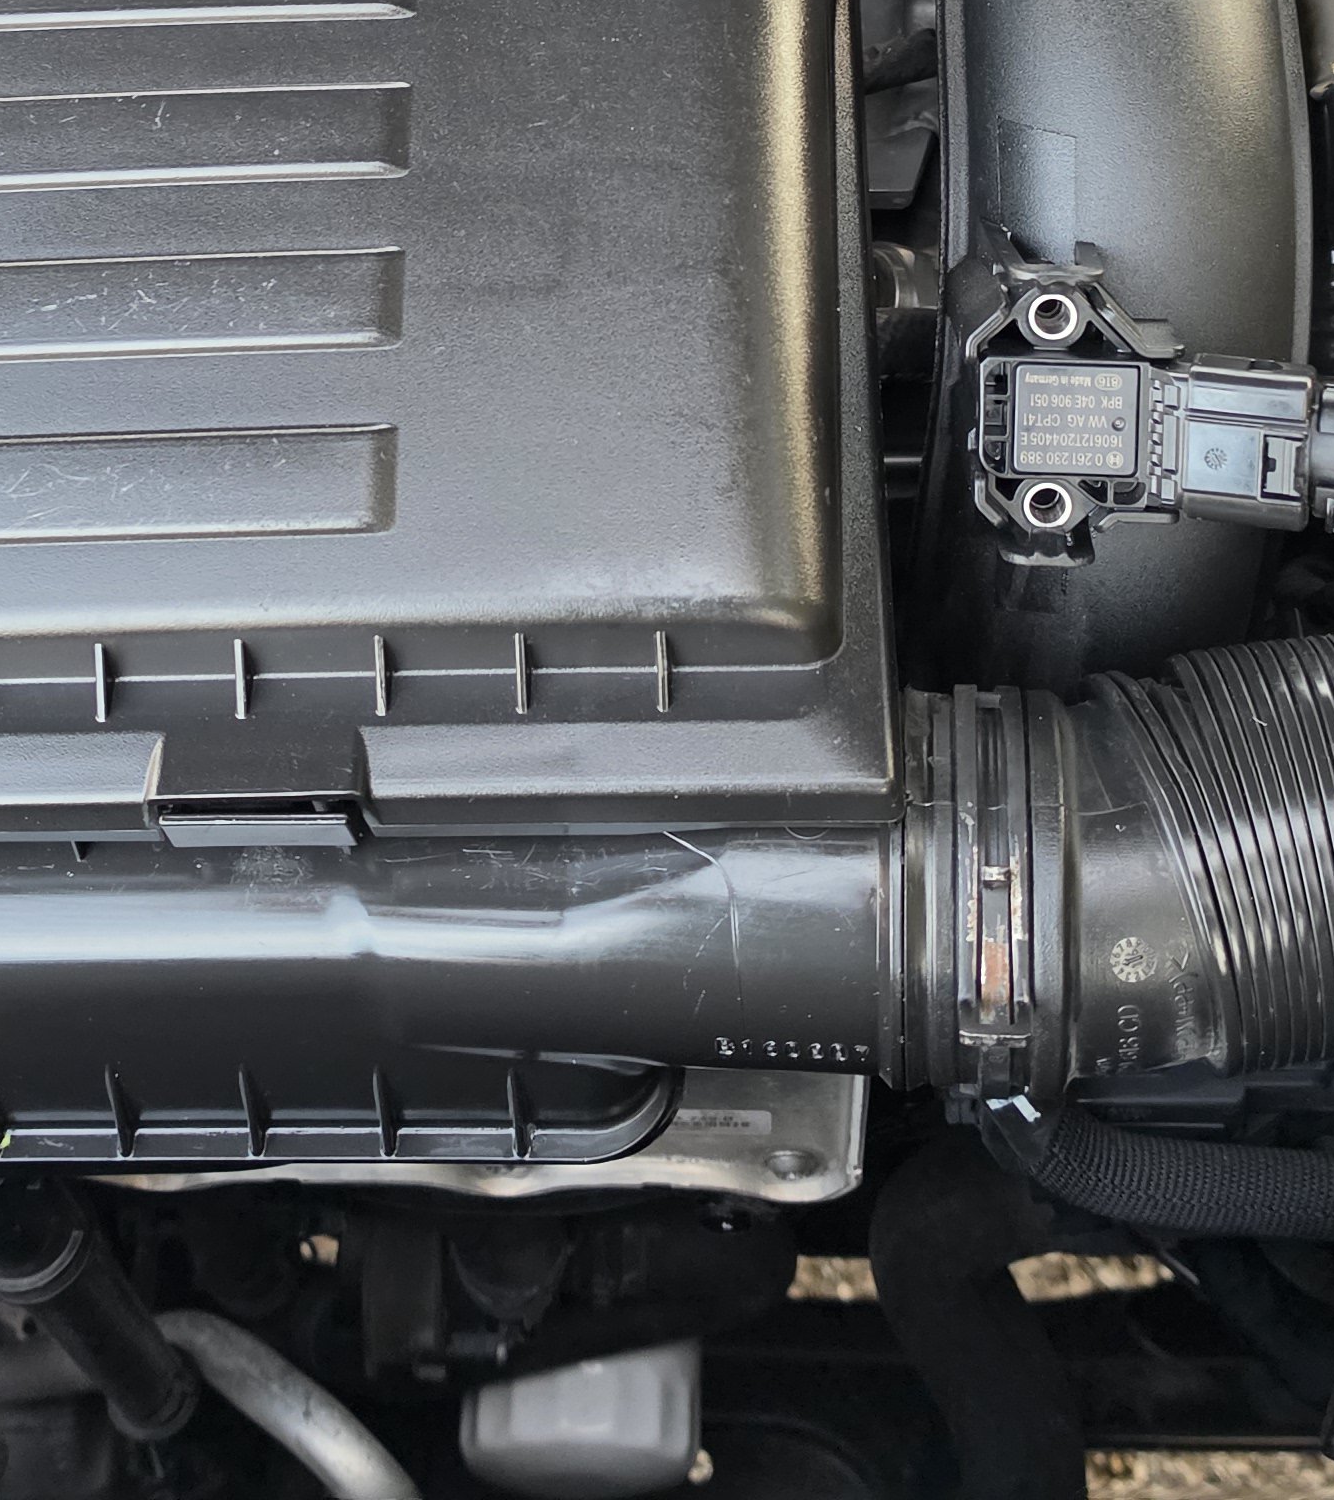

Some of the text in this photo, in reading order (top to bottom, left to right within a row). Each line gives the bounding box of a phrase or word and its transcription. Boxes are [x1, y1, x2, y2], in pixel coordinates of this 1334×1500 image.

[1025, 372, 1059, 386] Germany
[1060, 375, 1069, 386] in
[1070, 376, 1091, 387] Made
[1030, 393, 1123, 409] BPK 04E 906 051
[1023, 413, 1107, 428] VW AG CPT41
[1020, 451, 1043, 465] 389
[1046, 451, 1070, 466] 230
[1072, 452, 1092, 466] 261
